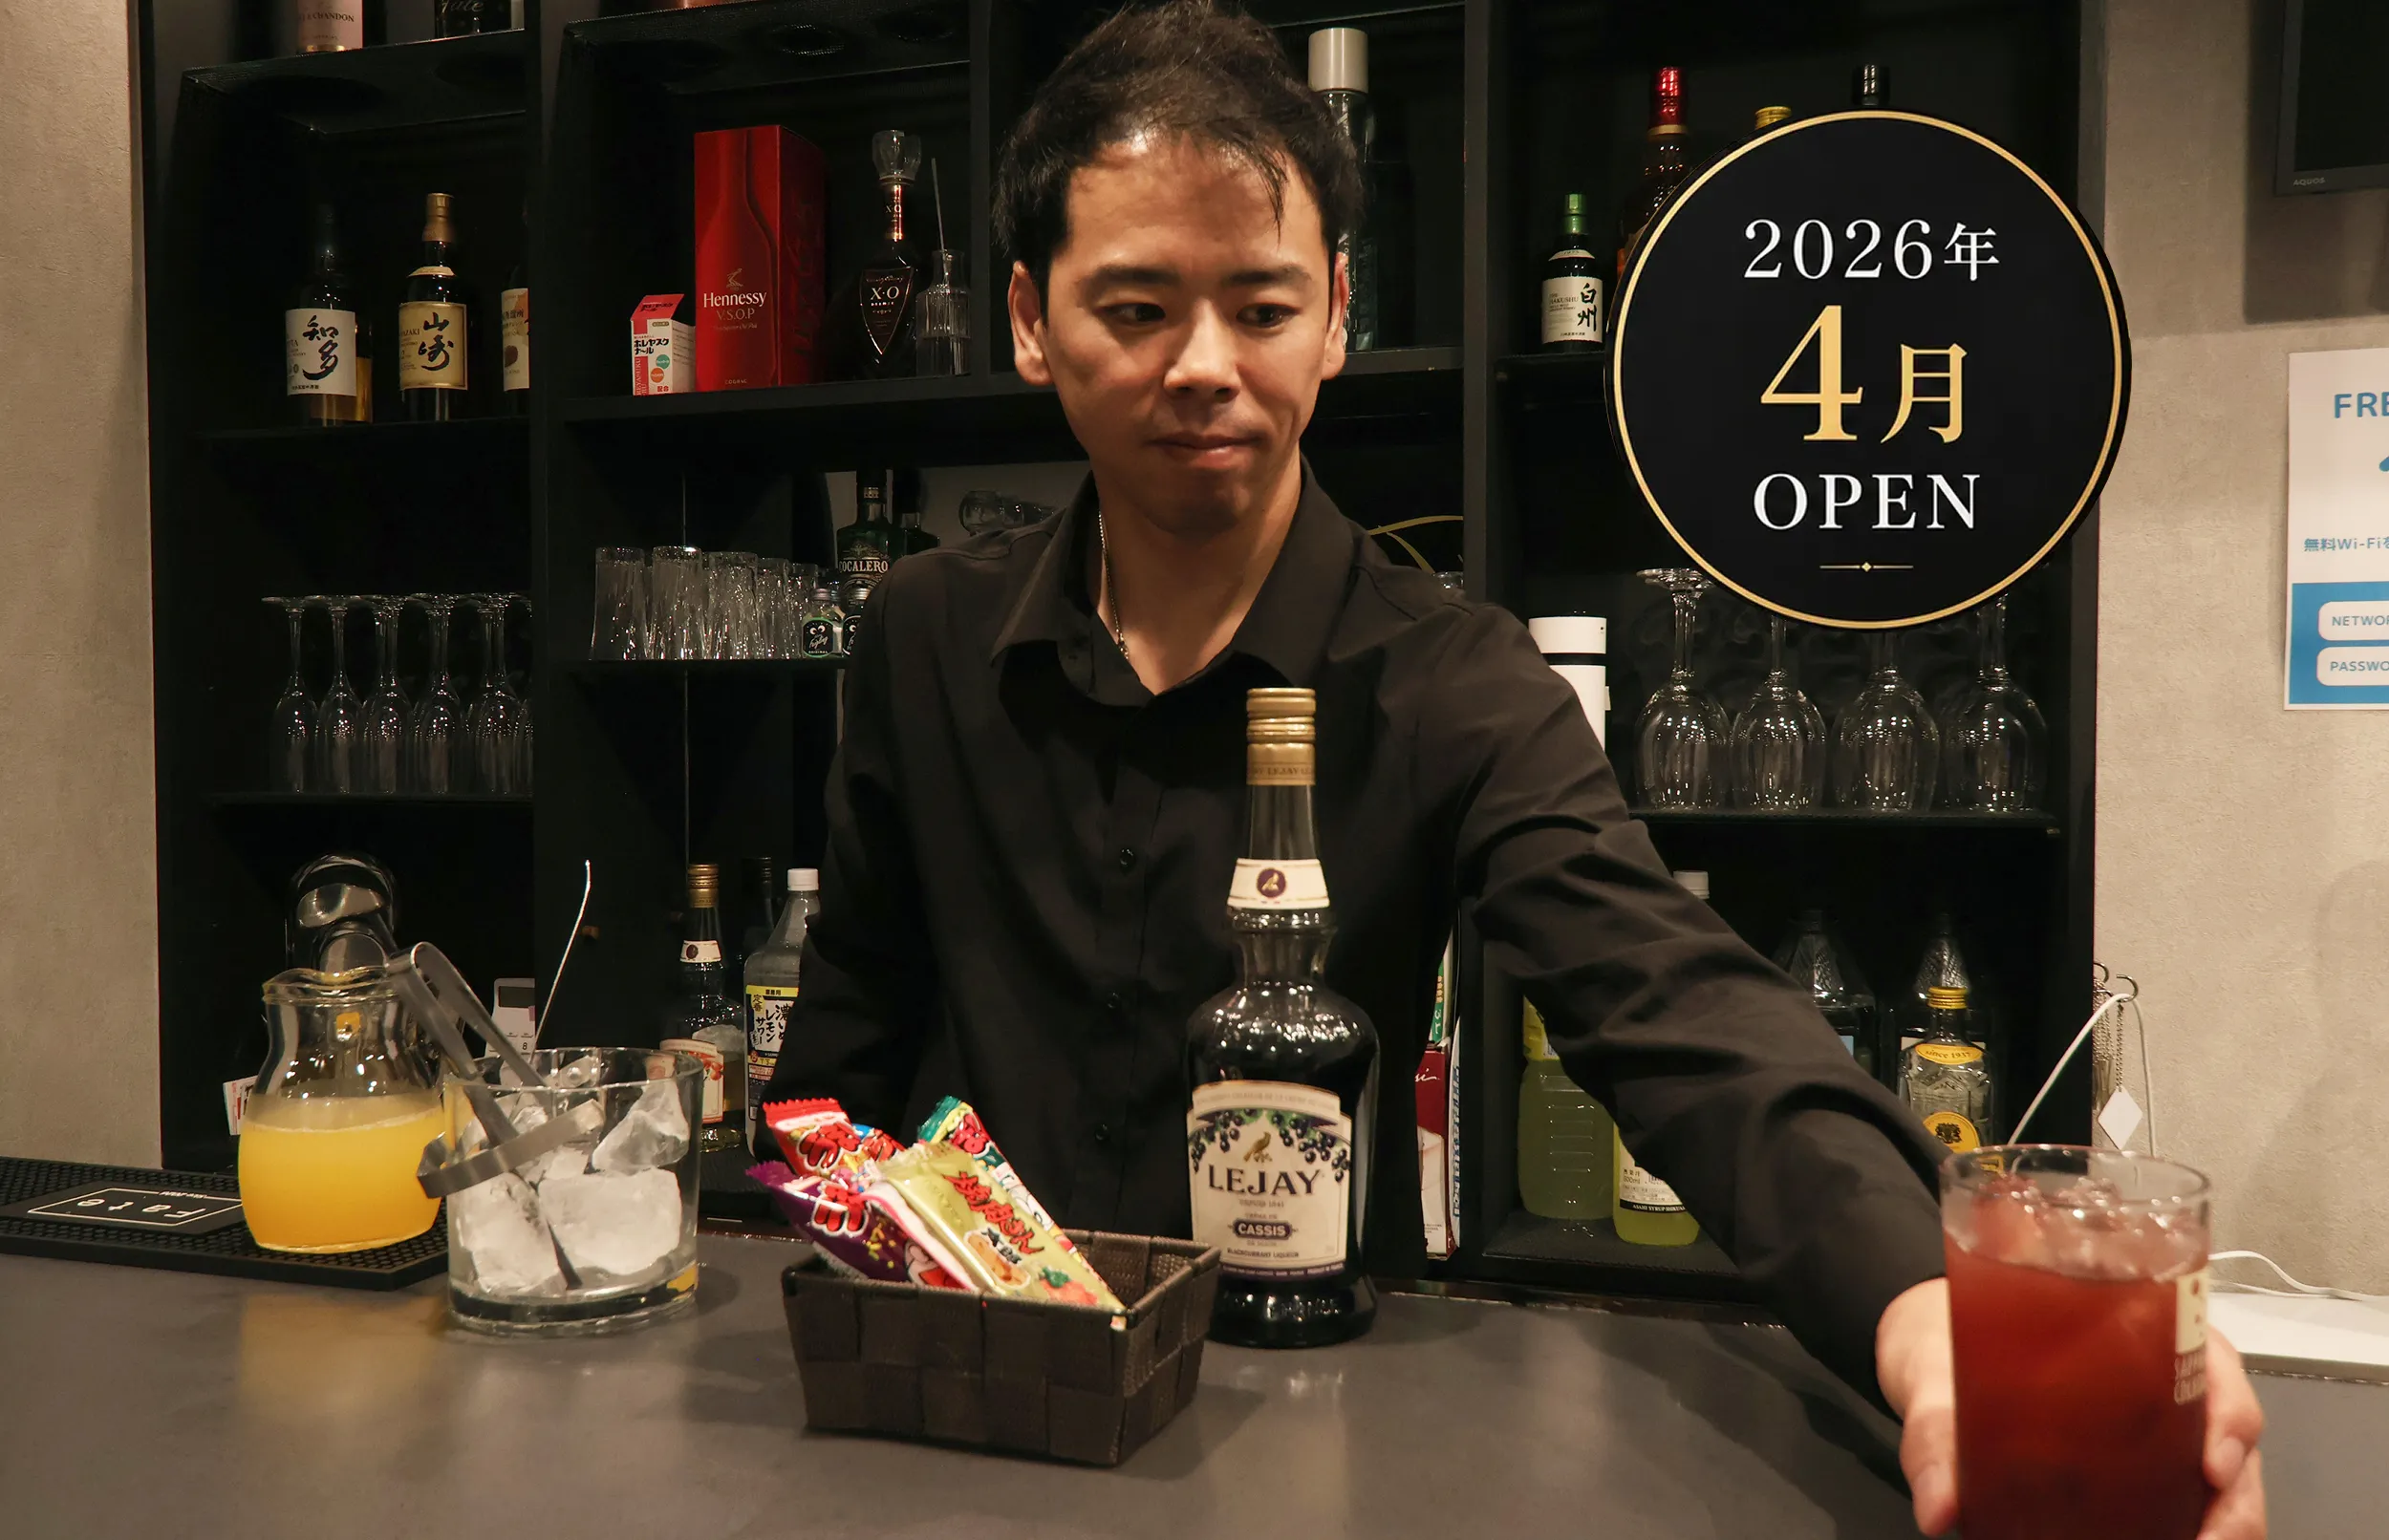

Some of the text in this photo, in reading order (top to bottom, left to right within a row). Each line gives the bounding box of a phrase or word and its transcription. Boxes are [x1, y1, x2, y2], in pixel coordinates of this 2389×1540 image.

[2292, 177, 2325, 186] AQUOS
[703, 291, 767, 308] Hennessy
[1577, 283, 1597, 332] 白州
[302, 314, 339, 381] 知多
[418, 311, 454, 371] 山崎
[634, 338, 669, 348] ホレヤスク
[756, 1016, 765, 1044] サワー
[765, 1009, 776, 1043] レモン
[522, 1041, 527, 1050] 8
[1208, 1165, 1321, 1196] LEJAY
[76, 1198, 206, 1219] Fate
[1238, 1223, 1286, 1238] CASSIS
